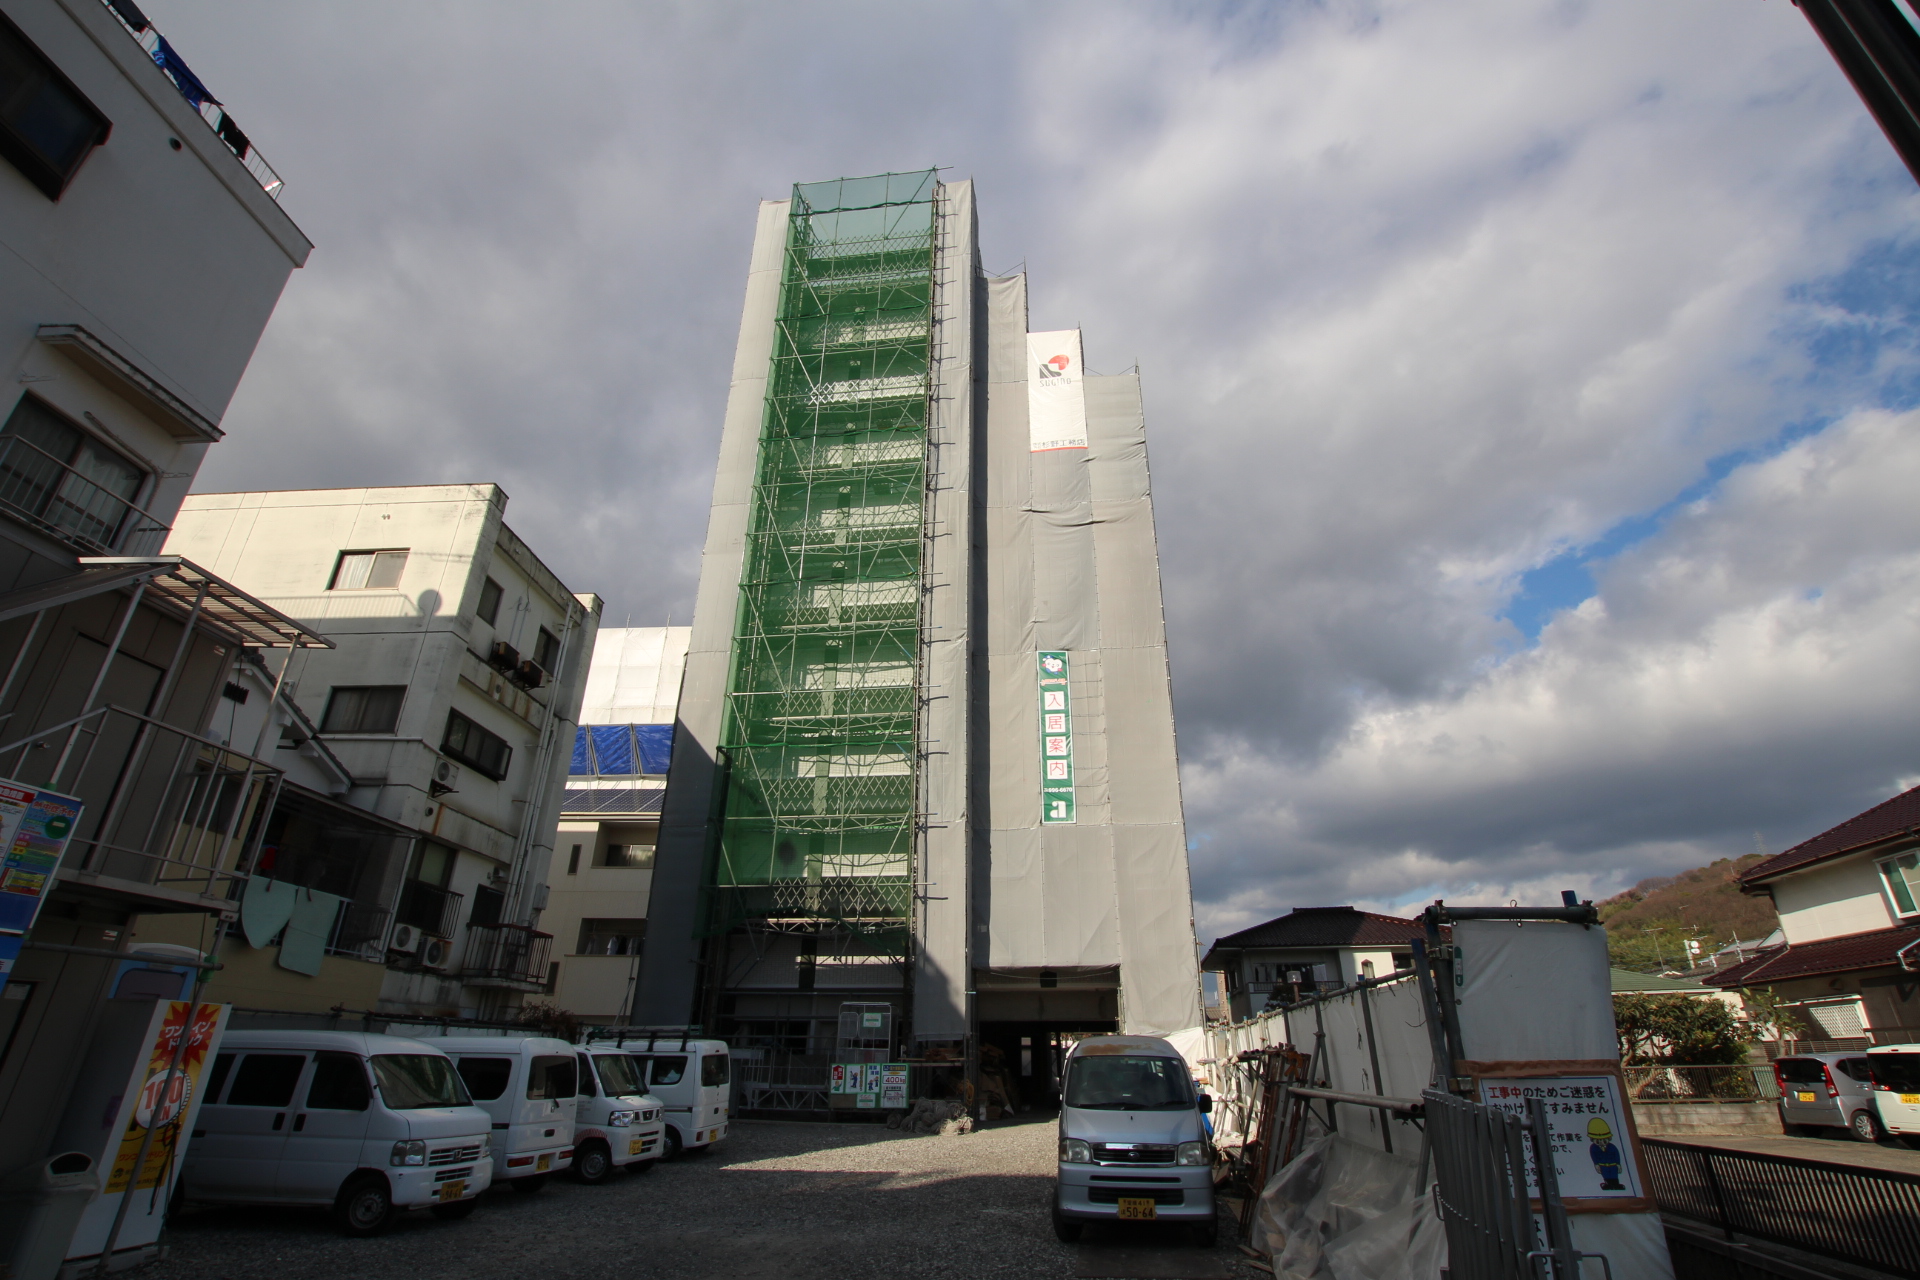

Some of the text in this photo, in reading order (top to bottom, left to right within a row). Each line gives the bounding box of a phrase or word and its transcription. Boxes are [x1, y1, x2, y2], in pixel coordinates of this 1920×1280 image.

[1047, 693, 1064, 776] 入居案内
[164, 1021, 211, 1038] ワンイン
[167, 1033, 204, 1051] ドク
[1488, 1086, 1605, 1099] 工事中のためご迷惑を
[1493, 1102, 1609, 1114] おかけすみません
[118, 1150, 170, 1162] ワンコドリン
[1126, 1206, 1154, 1218] 50-64
